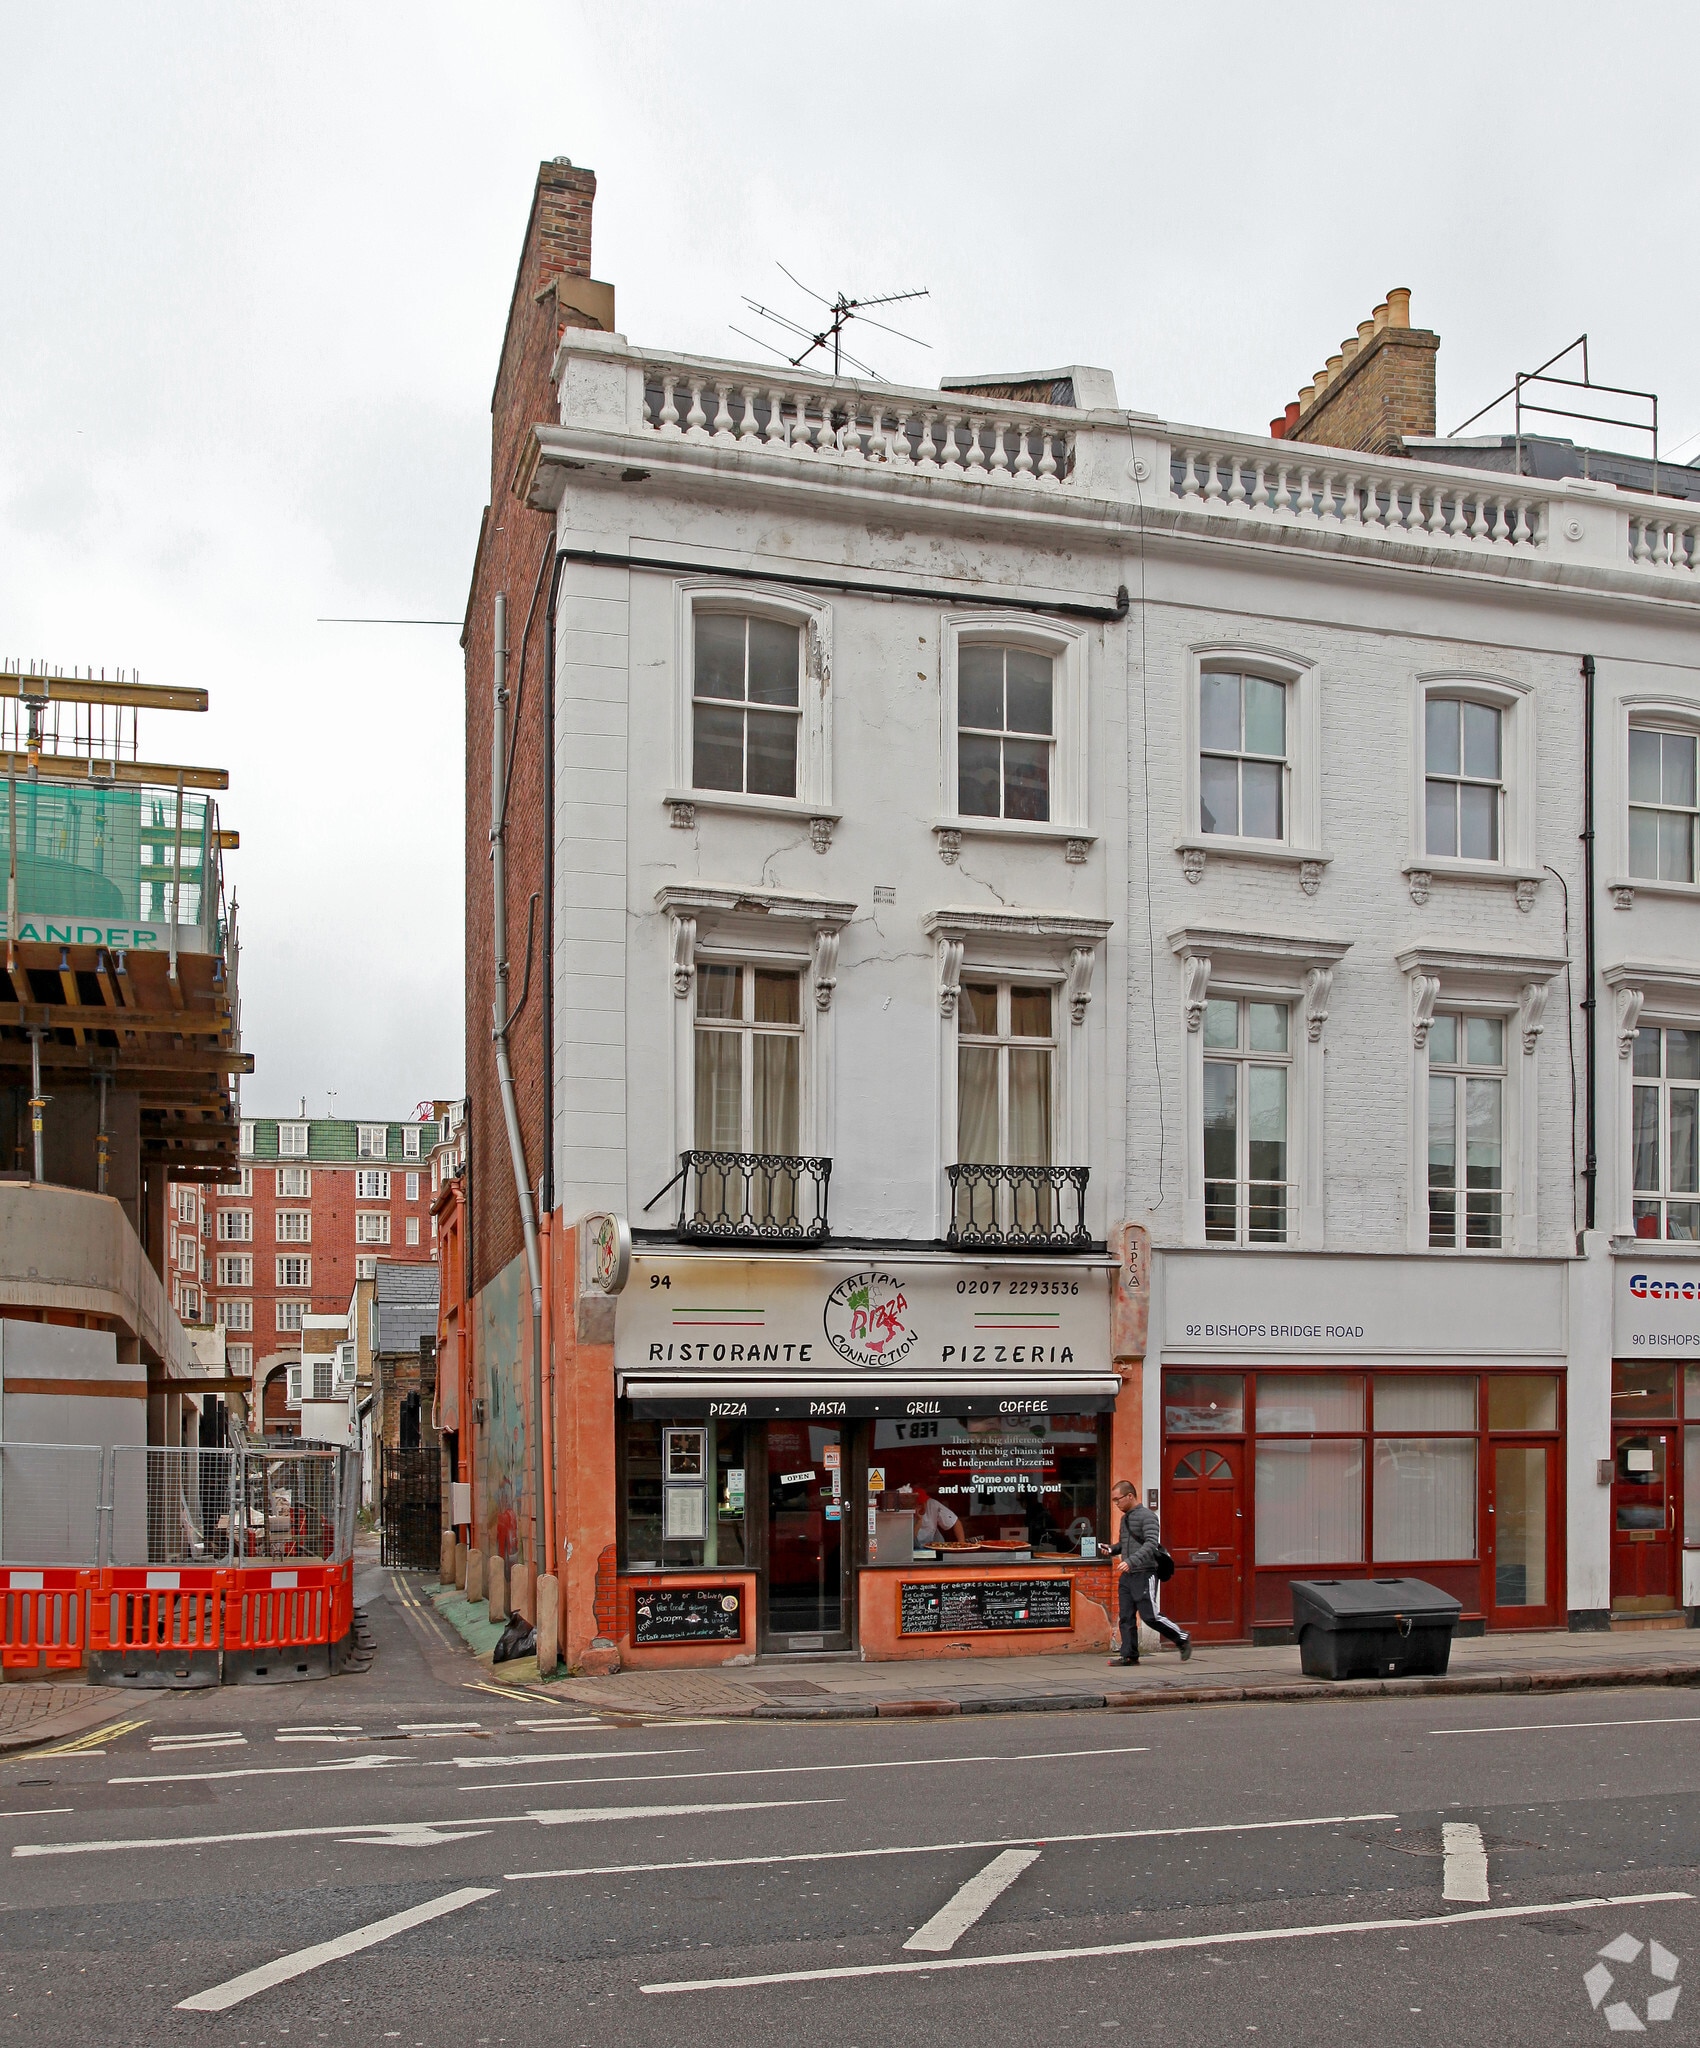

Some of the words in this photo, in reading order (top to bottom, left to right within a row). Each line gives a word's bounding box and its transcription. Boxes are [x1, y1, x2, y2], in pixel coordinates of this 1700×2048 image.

[650, 1275, 671, 1289] 94
[956, 1280, 1001, 1295] 0207
[1009, 1281, 1079, 1295] 2293536
[1630, 1274, 1700, 1299] Gene
[829, 1273, 905, 1306] ITALIAN
[850, 1293, 908, 1339] PIZZA
[1186, 1325, 1201, 1336] 92
[1205, 1325, 1266, 1337] BISHOPS
[1270, 1325, 1321, 1337] BRIDGE
[1326, 1326, 1364, 1338] ROAD
[1632, 1334, 1645, 1345] 90
[1649, 1334, 1700, 1346] BISHOPS
[649, 1343, 812, 1362] RISTORANTE
[832, 1329, 918, 1366] CONNECTION
[942, 1345, 1074, 1363] PIZZERIA
[709, 1402, 747, 1416] PIZZA
[810, 1402, 846, 1415] PASTA
[906, 1401, 941, 1415] GRILL
[999, 1400, 1049, 1413] COFFEE
[950, 1435, 981, 1444] There's
[989, 1435, 1001, 1445] big
[1004, 1435, 1046, 1444] difference
[941, 1447, 977, 1456] between
[979, 1447, 989, 1455] the
[995, 1447, 1008, 1457] big
[1010, 1446, 1037, 1455] chains
[1039, 1446, 1054, 1455] and
[942, 1458, 956, 1467] the
[958, 1458, 1013, 1469] Independent
[1016, 1457, 1054, 1466] Pizzerias
[787, 1473, 810, 1482] OPEN
[972, 1475, 1001, 1484] Come
[1004, 1476, 1017, 1484] on
[1019, 1474, 1029, 1484] in
[938, 1485, 958, 1494] and
[961, 1484, 984, 1494] we'll
[987, 1485, 1015, 1495] prove
[1018, 1483, 1026, 1493] it
[1027, 1484, 1038, 1493] to
[1040, 1483, 1061, 1494] you!
